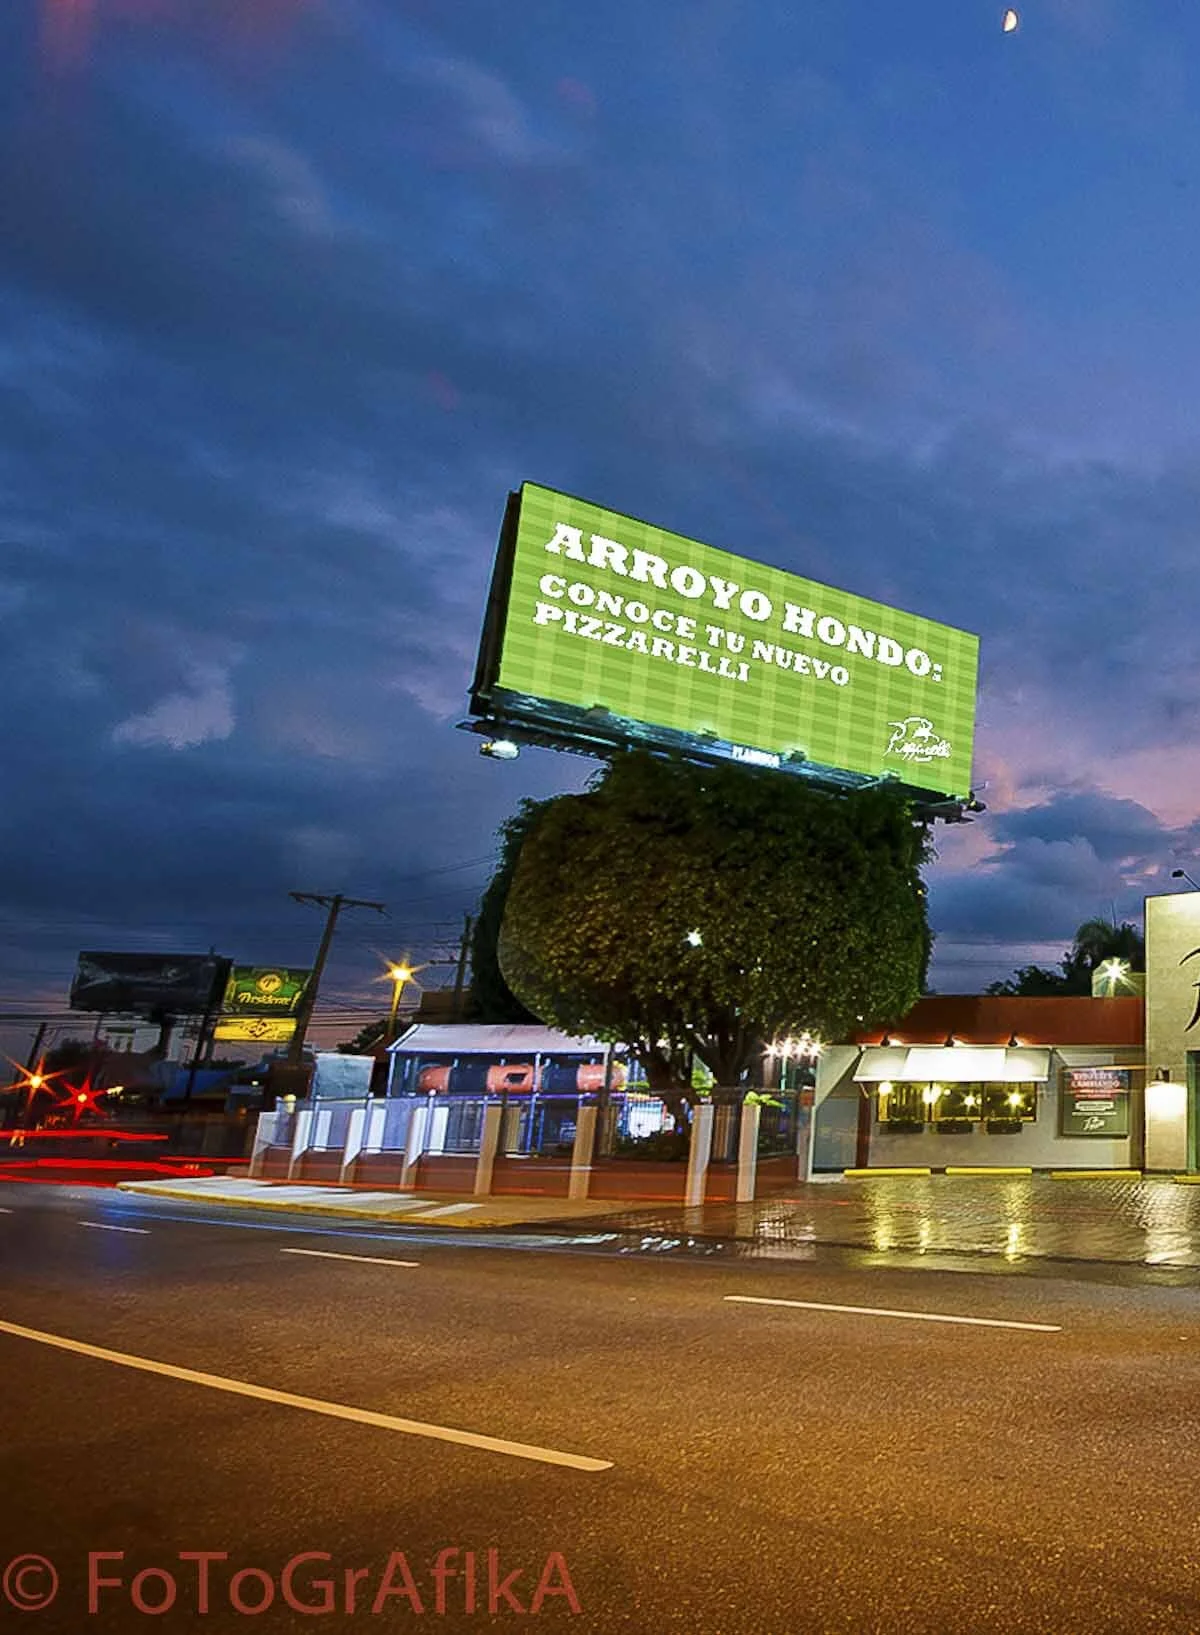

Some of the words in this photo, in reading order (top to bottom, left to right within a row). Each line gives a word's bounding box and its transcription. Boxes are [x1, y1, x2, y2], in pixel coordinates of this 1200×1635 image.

[533, 601, 750, 682] PIZZARELLI
[539, 574, 697, 640] CONOCE
[705, 624, 745, 653] TU
[752, 640, 849, 686] NUEVO
[545, 522, 773, 621] ARROYO
[782, 602, 942, 682] HONDO:
